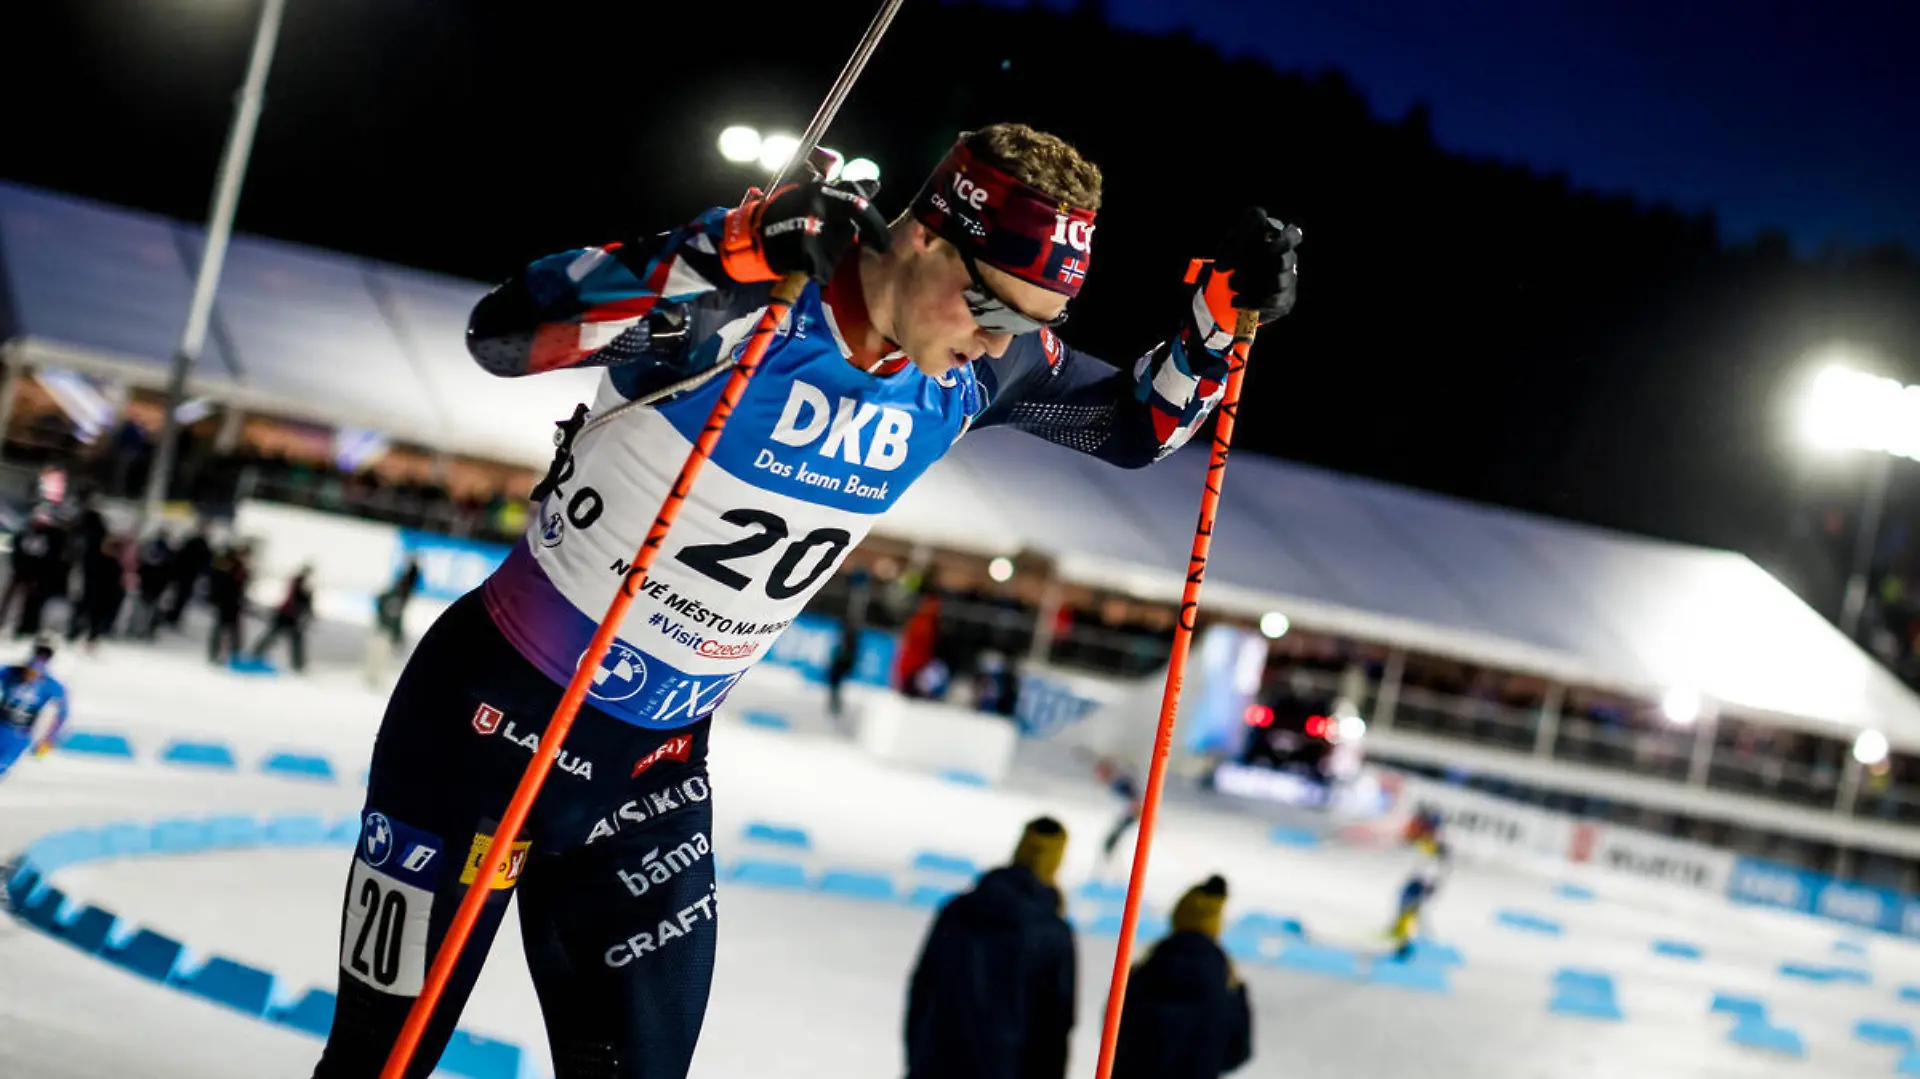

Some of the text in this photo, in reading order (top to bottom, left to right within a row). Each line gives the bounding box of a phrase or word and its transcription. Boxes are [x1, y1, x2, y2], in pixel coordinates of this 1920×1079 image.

[770, 379, 913, 471] DKB
[754, 448, 889, 500] Das kann Bank
[610, 558, 669, 600] NVÉ
[731, 619, 757, 635] NA
[675, 509, 851, 600] 20
[503, 721, 593, 780] LAUA
[351, 878, 408, 986] 20
